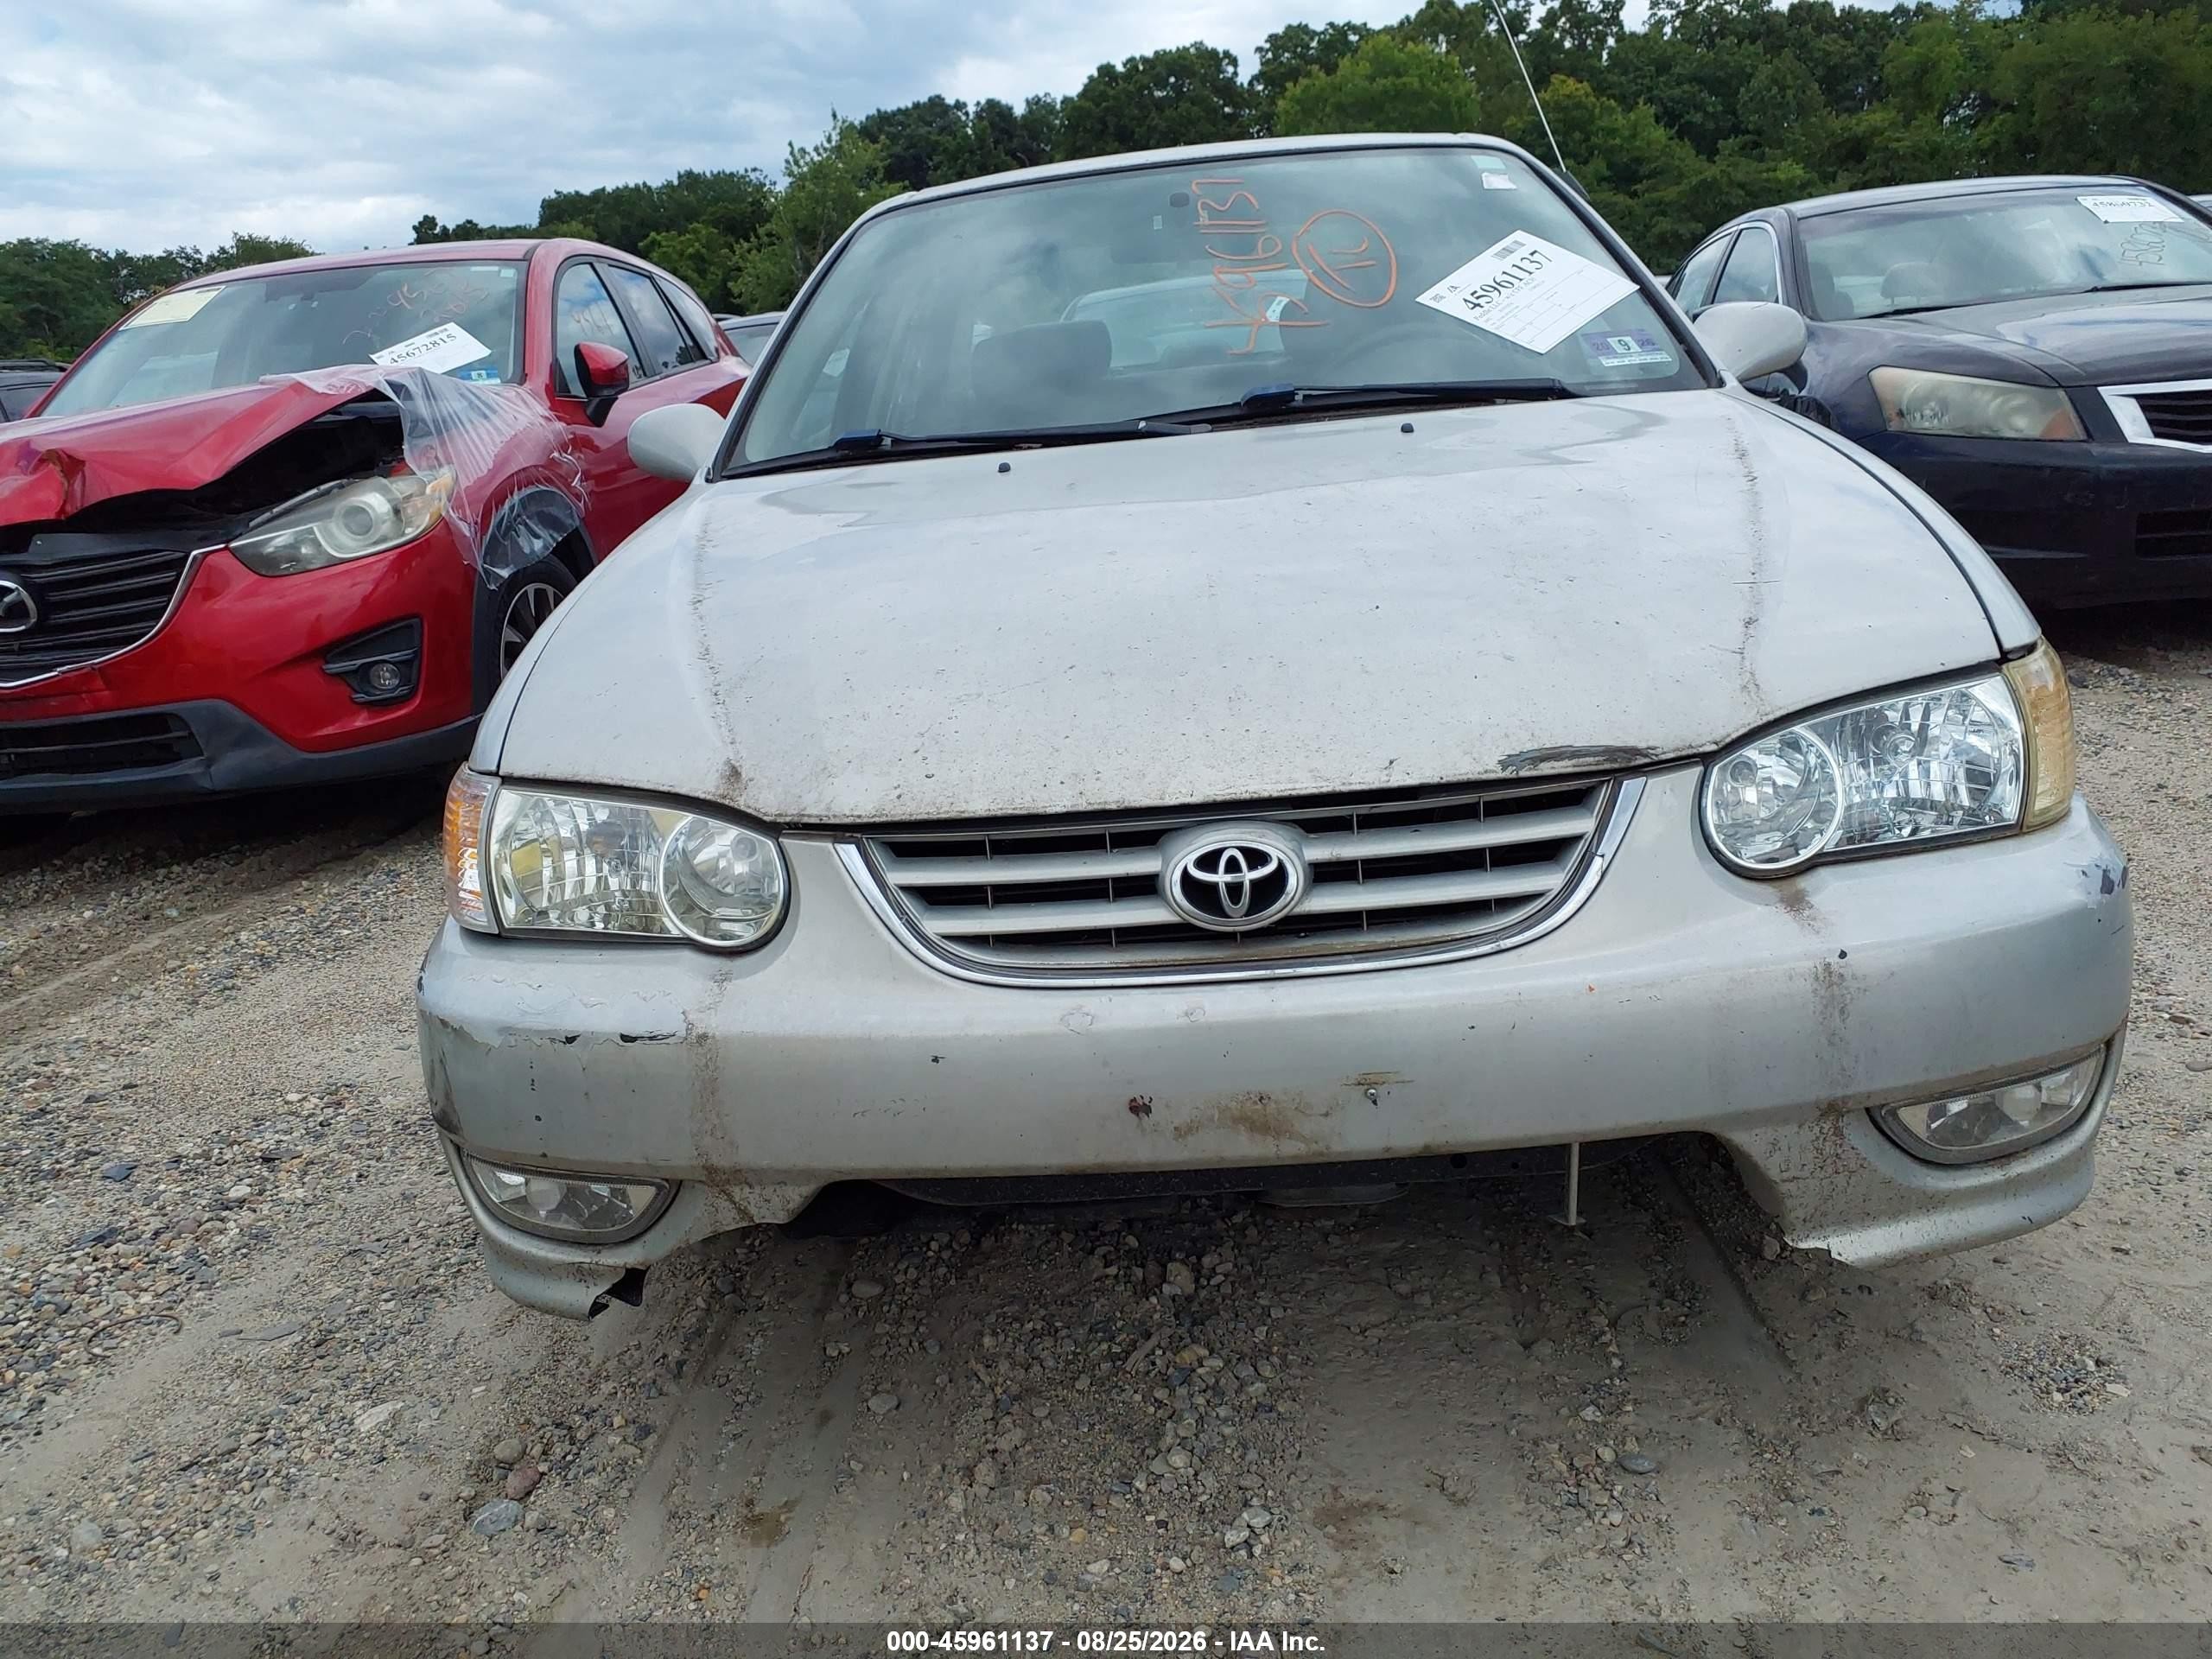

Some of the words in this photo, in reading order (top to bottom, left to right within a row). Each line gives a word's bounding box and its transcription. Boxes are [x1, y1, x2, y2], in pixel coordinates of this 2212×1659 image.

[1461, 249, 1554, 314] 45961137
[389, 333, 457, 365] 45672815
[1617, 338, 1631, 352] 9
